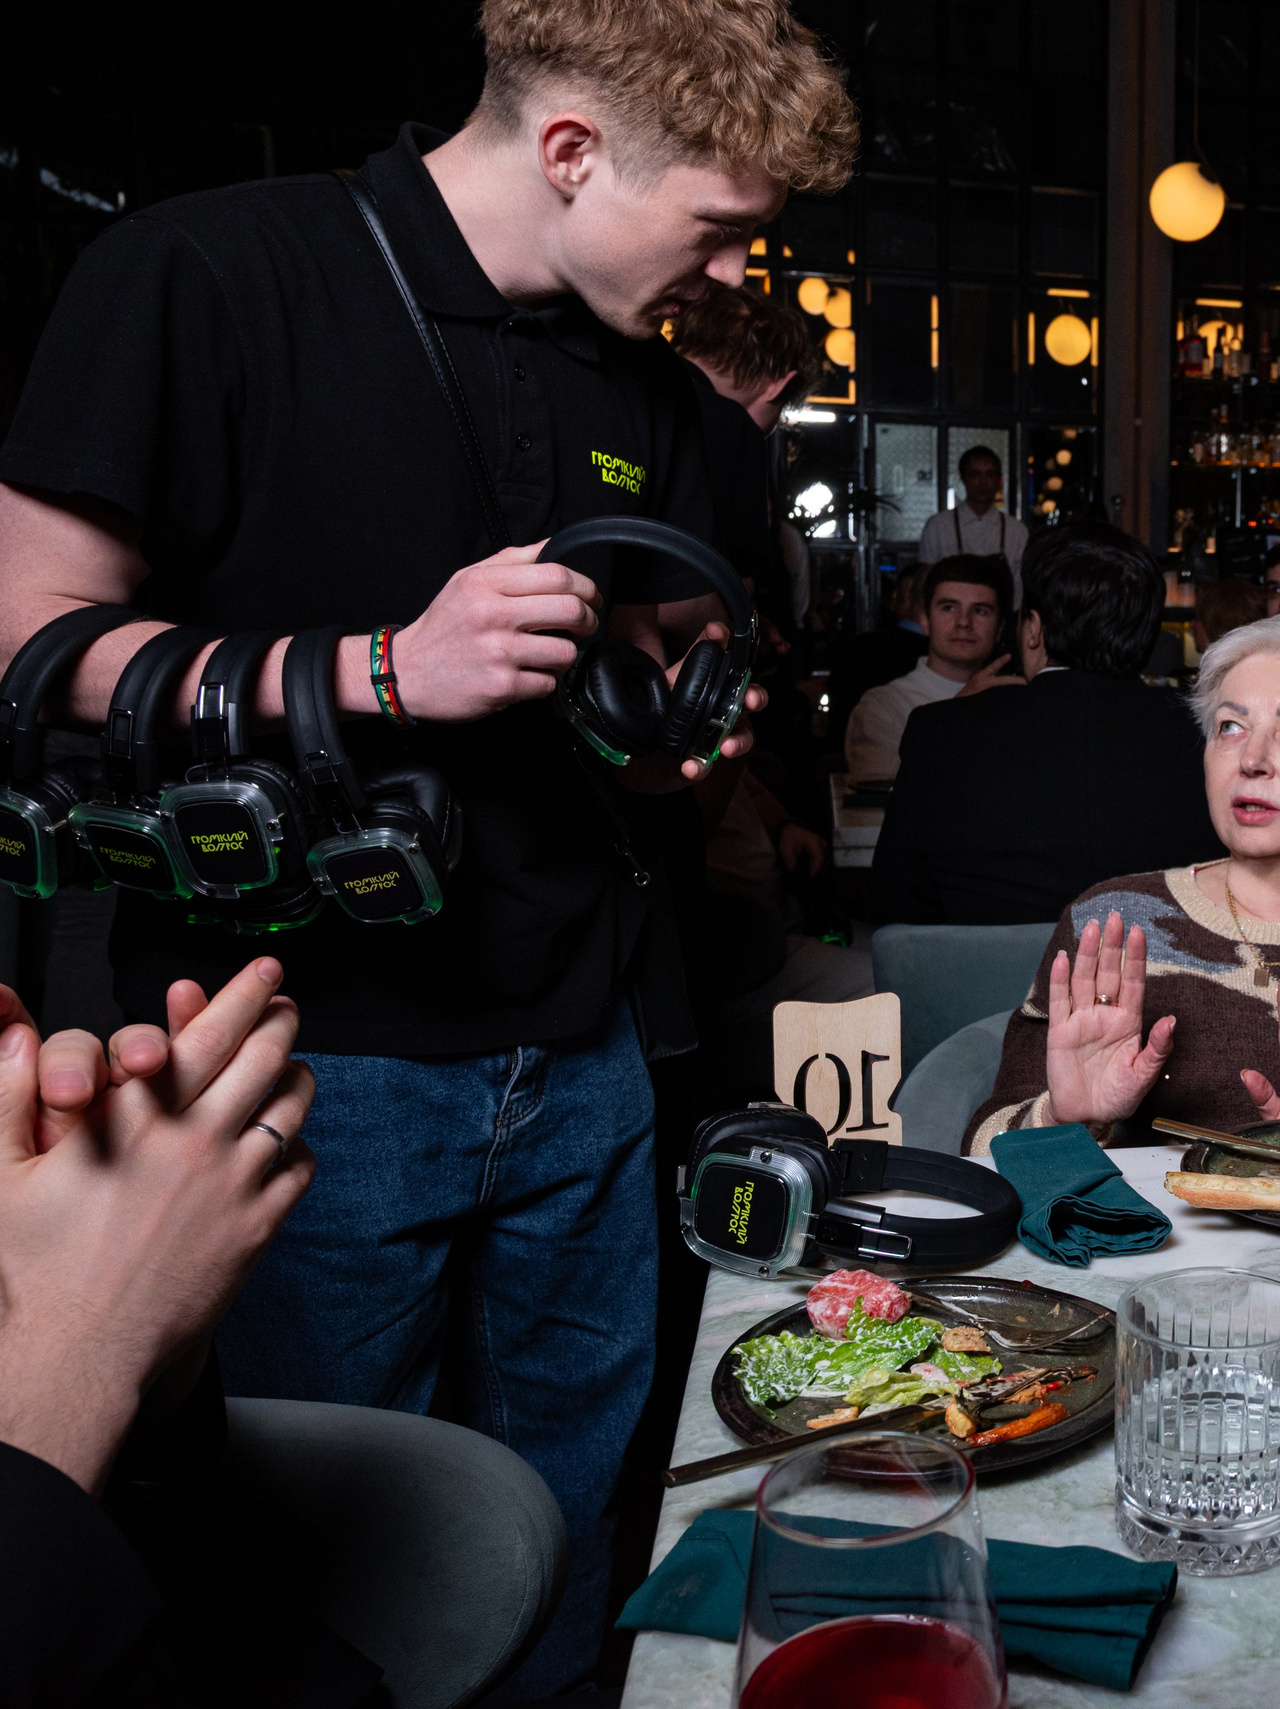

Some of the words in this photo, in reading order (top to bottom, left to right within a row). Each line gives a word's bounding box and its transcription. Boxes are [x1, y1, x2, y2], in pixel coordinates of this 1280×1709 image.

[591, 450, 646, 483] ГРОМКИЙ
[601, 467, 641, 495] ВОПРОС
[190, 830, 249, 845] ГРОМКИЙ
[201, 841, 245, 853] ВОПРОС
[99, 847, 156, 866] ГРОМКИЙ
[109, 854, 152, 871] ВОПРОС
[343, 870, 401, 890] ГРОМКИЙ
[354, 880, 397, 895] ВОПРОС
[727, 1186, 744, 1235] ВОПРОС
[735, 1180, 755, 1246] ГРОМКИЙ
